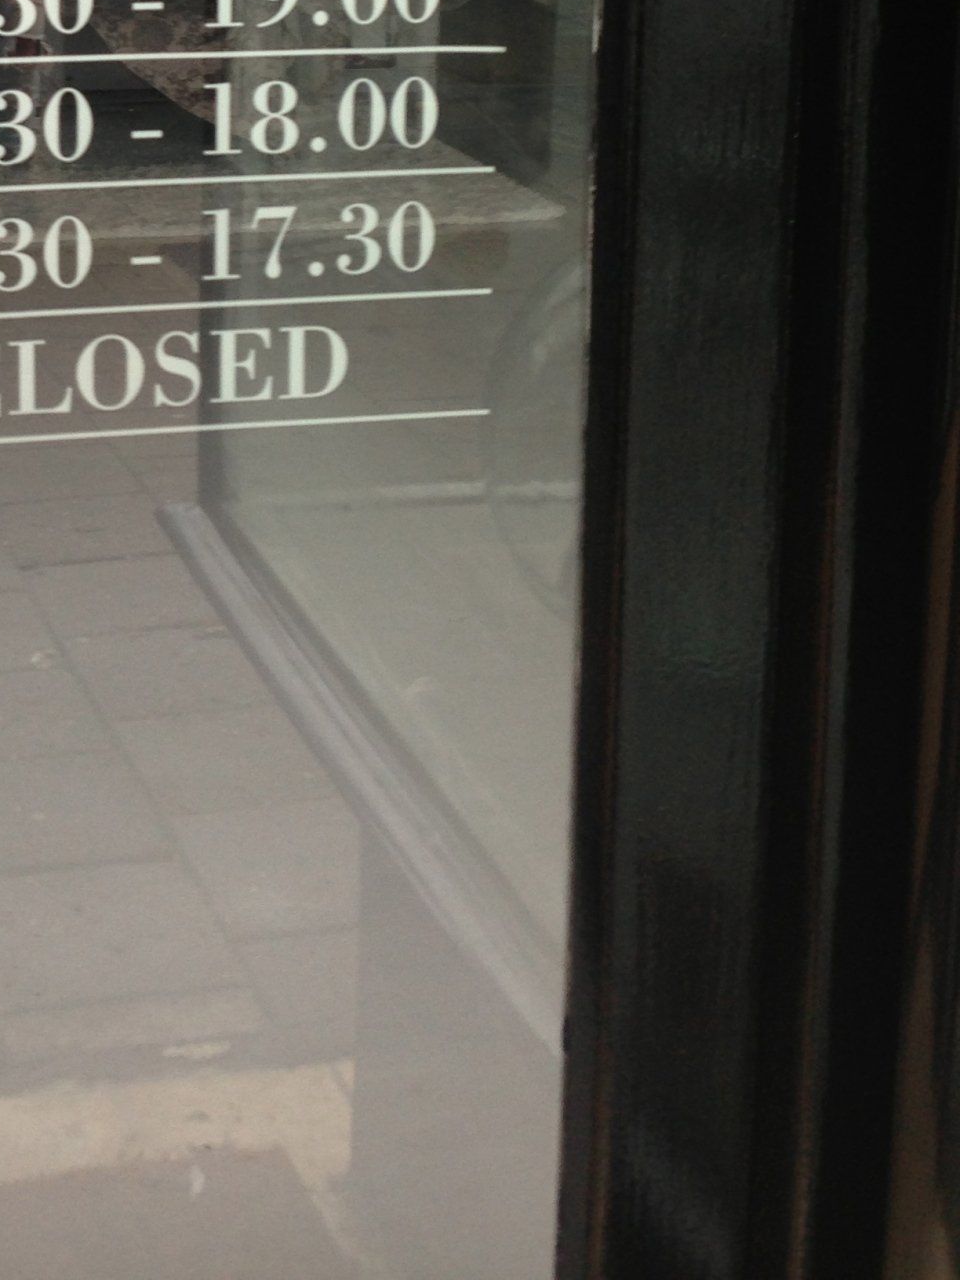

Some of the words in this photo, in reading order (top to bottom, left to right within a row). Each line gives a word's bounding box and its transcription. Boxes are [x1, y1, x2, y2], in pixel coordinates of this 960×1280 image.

[133, 2, 164, 10] -
[133, 130, 162, 139] -
[205, 77, 437, 154] 18.00
[132, 256, 161, 265] -
[202, 200, 437, 281] 17.30
